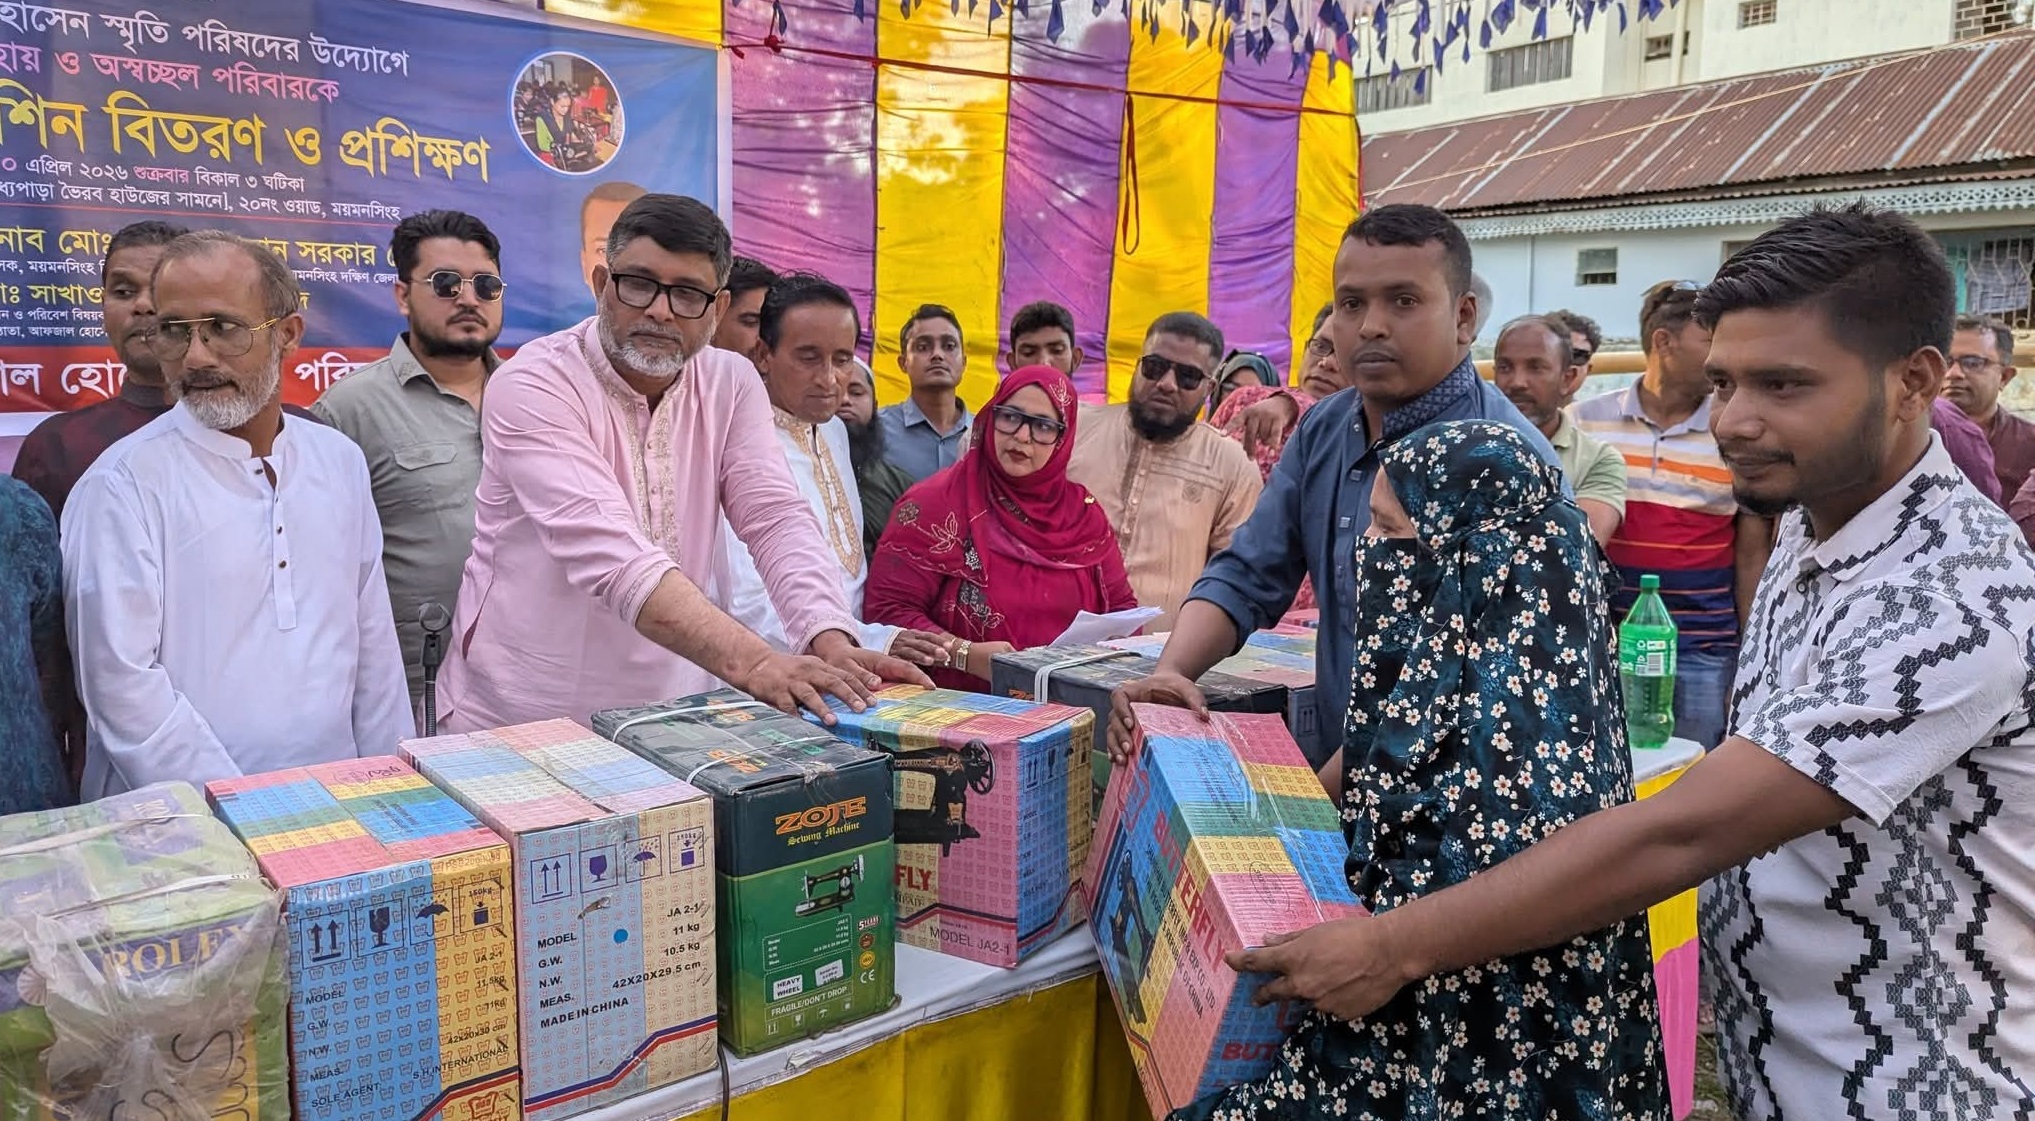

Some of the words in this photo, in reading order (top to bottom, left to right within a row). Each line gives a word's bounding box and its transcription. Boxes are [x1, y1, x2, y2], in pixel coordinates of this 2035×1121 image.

[99, 10, 171, 54] স্মৃতি
[182, 19, 300, 63] পরিষদের
[307, 33, 410, 77] উদ্যোগে
[54, 52, 80, 75] ও
[212, 61, 340, 104] পরিবারকে
[0, 79, 89, 154] শিন
[101, 90, 267, 166] বিতরণ
[285, 127, 321, 166] ও
[339, 117, 491, 184] প্রশিক্ষণ
[25, 155, 72, 177] এপ্রিল
[80, 163, 128, 181] ২০২৬
[134, 165, 190, 185] শুক্রবার
[195, 165, 240, 188] বিকাল
[245, 175, 258, 188] ৩
[262, 171, 305, 193] ঘটিকা
[0, 181, 54, 202] ধ্যপাড়া
[59, 179, 103, 202] ভৈরব
[108, 184, 171, 206] হাউজের
[239, 196, 280, 213] ২০নং
[331, 200, 401, 221] ময়মনসিংহ
[294, 241, 377, 268] সরকার
[27, 258, 97, 276] ময়মনসিংহ
[341, 269, 370, 284] দক্ষিণ
[27, 283, 105, 305] সাখাও
[27, 307, 68, 321] পরিবেশ
[28, 326, 75, 337] আফজাল
[775, 795, 867, 836] ZOJE
[787, 831, 822, 847] Sewing
[824, 820, 861, 839] Machine
[895, 864, 932, 892] FLY
[667, 907, 681, 918] JA
[673, 925, 684, 936] 11
[687, 922, 700, 932] kg
[537, 932, 577, 949] MODEL
[930, 925, 974, 948] MODEL
[976, 938, 1011, 956] JA2-1
[663, 944, 685, 957] 10.5
[687, 941, 701, 951] kg
[538, 955, 563, 969] G.W.
[539, 975, 563, 989] N.W.
[612, 964, 682, 989] 42X20X29.5
[684, 961, 701, 971] cm
[777, 976, 802, 988] HEAVY
[306, 990, 345, 1005] MODEL
[777, 986, 801, 998] WHEEL
[827, 986, 848, 999] DROP
[540, 993, 575, 1009] MEAS.
[540, 1011, 575, 1029] MADE
[576, 1007, 589, 1019] IN
[591, 996, 630, 1014] CHINA
[307, 1018, 331, 1031] G.W.
[308, 1044, 332, 1057] N.W.
[309, 1066, 343, 1082] MEAS.
[311, 1093, 341, 1109] SOLE
